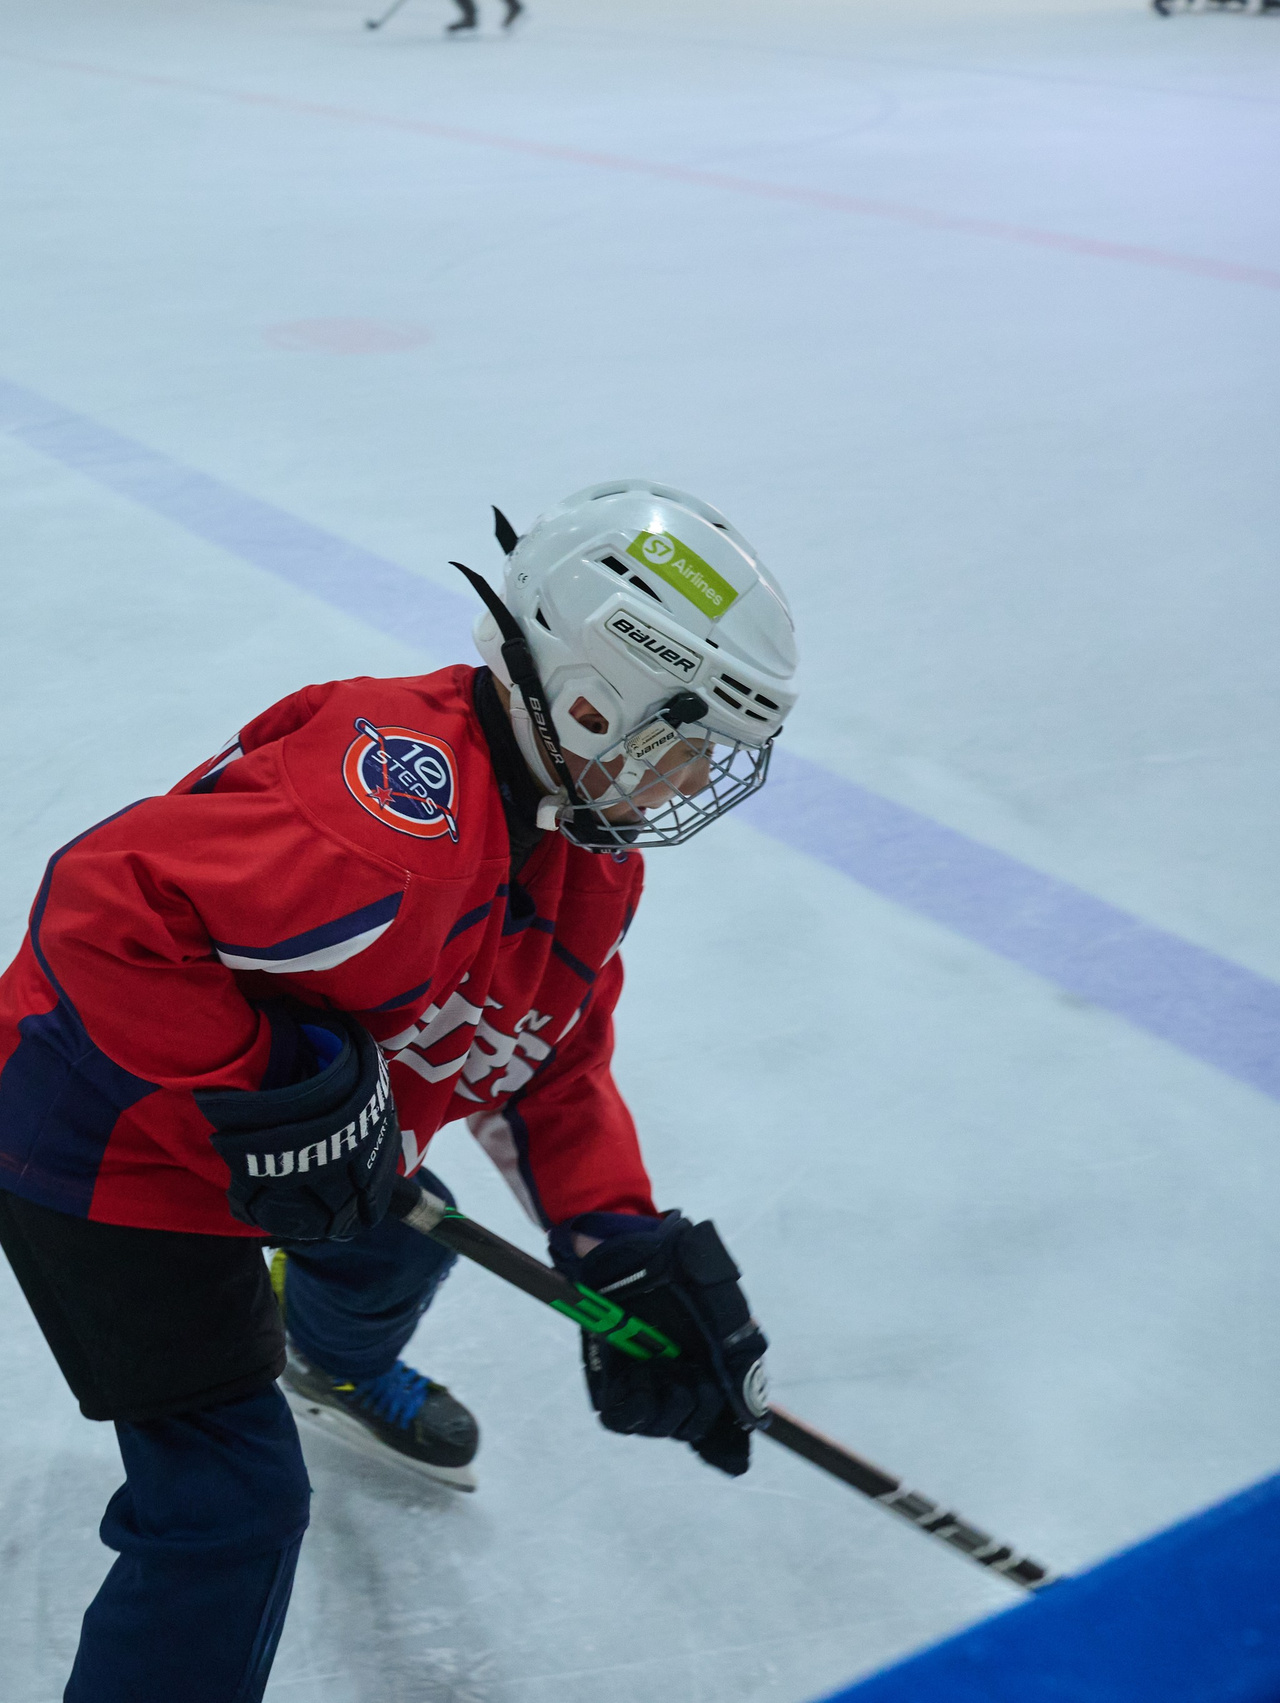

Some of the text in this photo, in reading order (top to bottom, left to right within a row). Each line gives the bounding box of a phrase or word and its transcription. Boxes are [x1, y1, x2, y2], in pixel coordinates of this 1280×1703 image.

[643, 535, 724, 607] S7 Airlines
[612, 617, 696, 674] BAUER
[370, 750, 438, 815] STEPS
[400, 743, 447, 790] 10
[366, 1116, 389, 1170] COVERT
